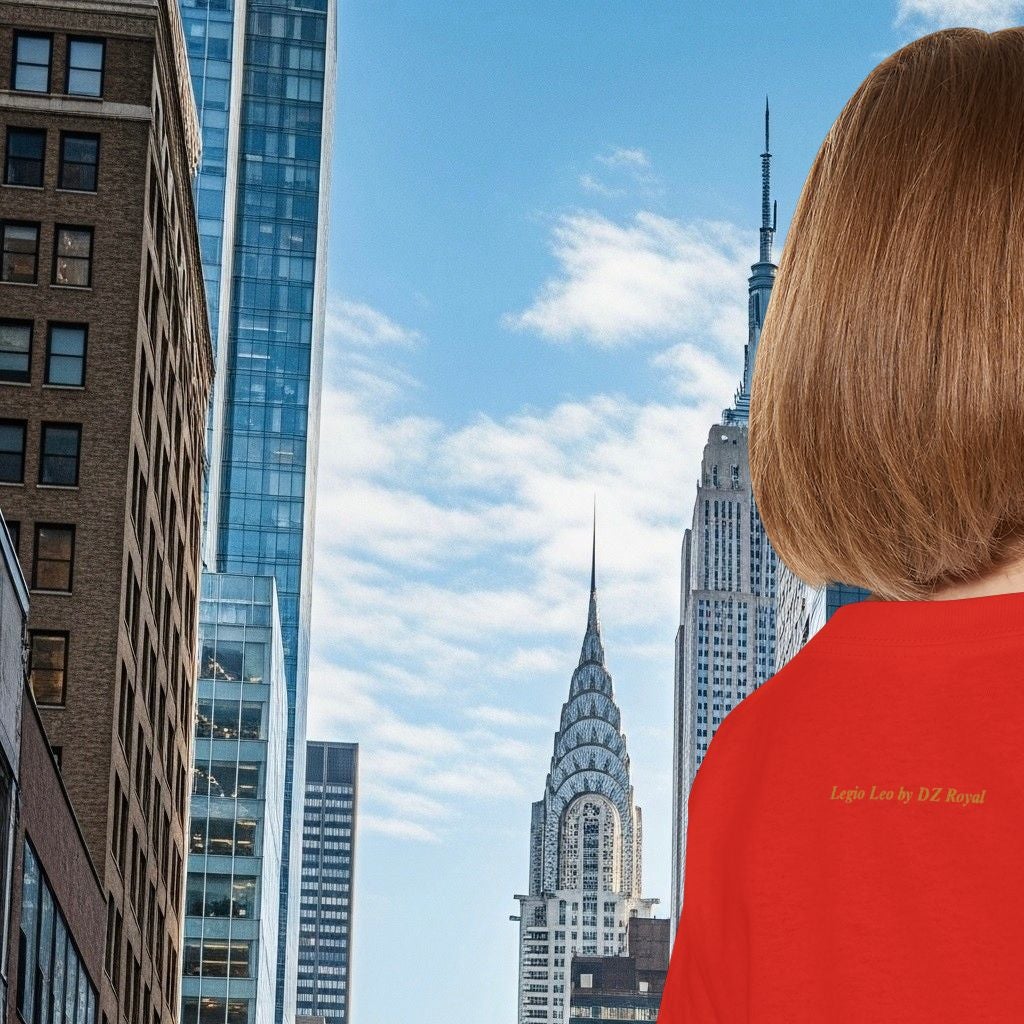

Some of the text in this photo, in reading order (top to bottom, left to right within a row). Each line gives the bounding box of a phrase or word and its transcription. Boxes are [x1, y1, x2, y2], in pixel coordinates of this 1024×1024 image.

[831, 785, 987, 807] Legio Leo by DZ Royal
